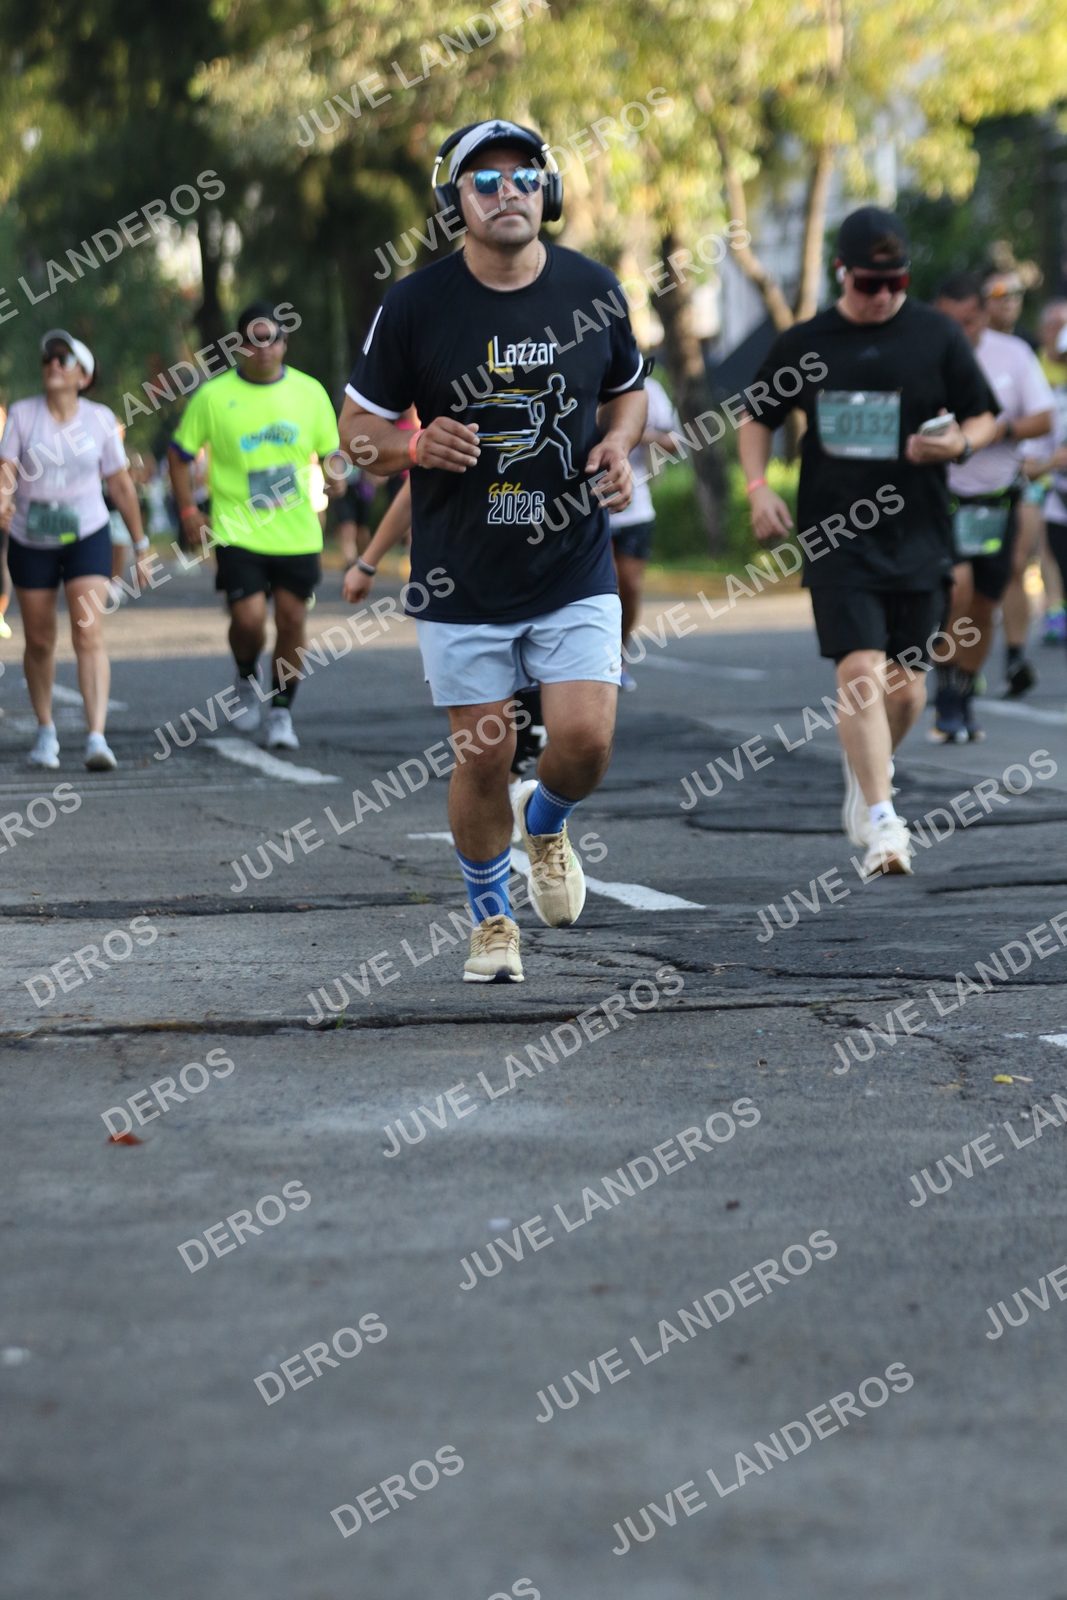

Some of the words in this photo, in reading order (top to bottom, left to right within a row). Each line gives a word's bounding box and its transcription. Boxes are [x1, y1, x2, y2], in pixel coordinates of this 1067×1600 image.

[489, 335, 557, 371] Lazzar
[836, 409, 897, 437] 0132
[487, 490, 545, 524] 2026
